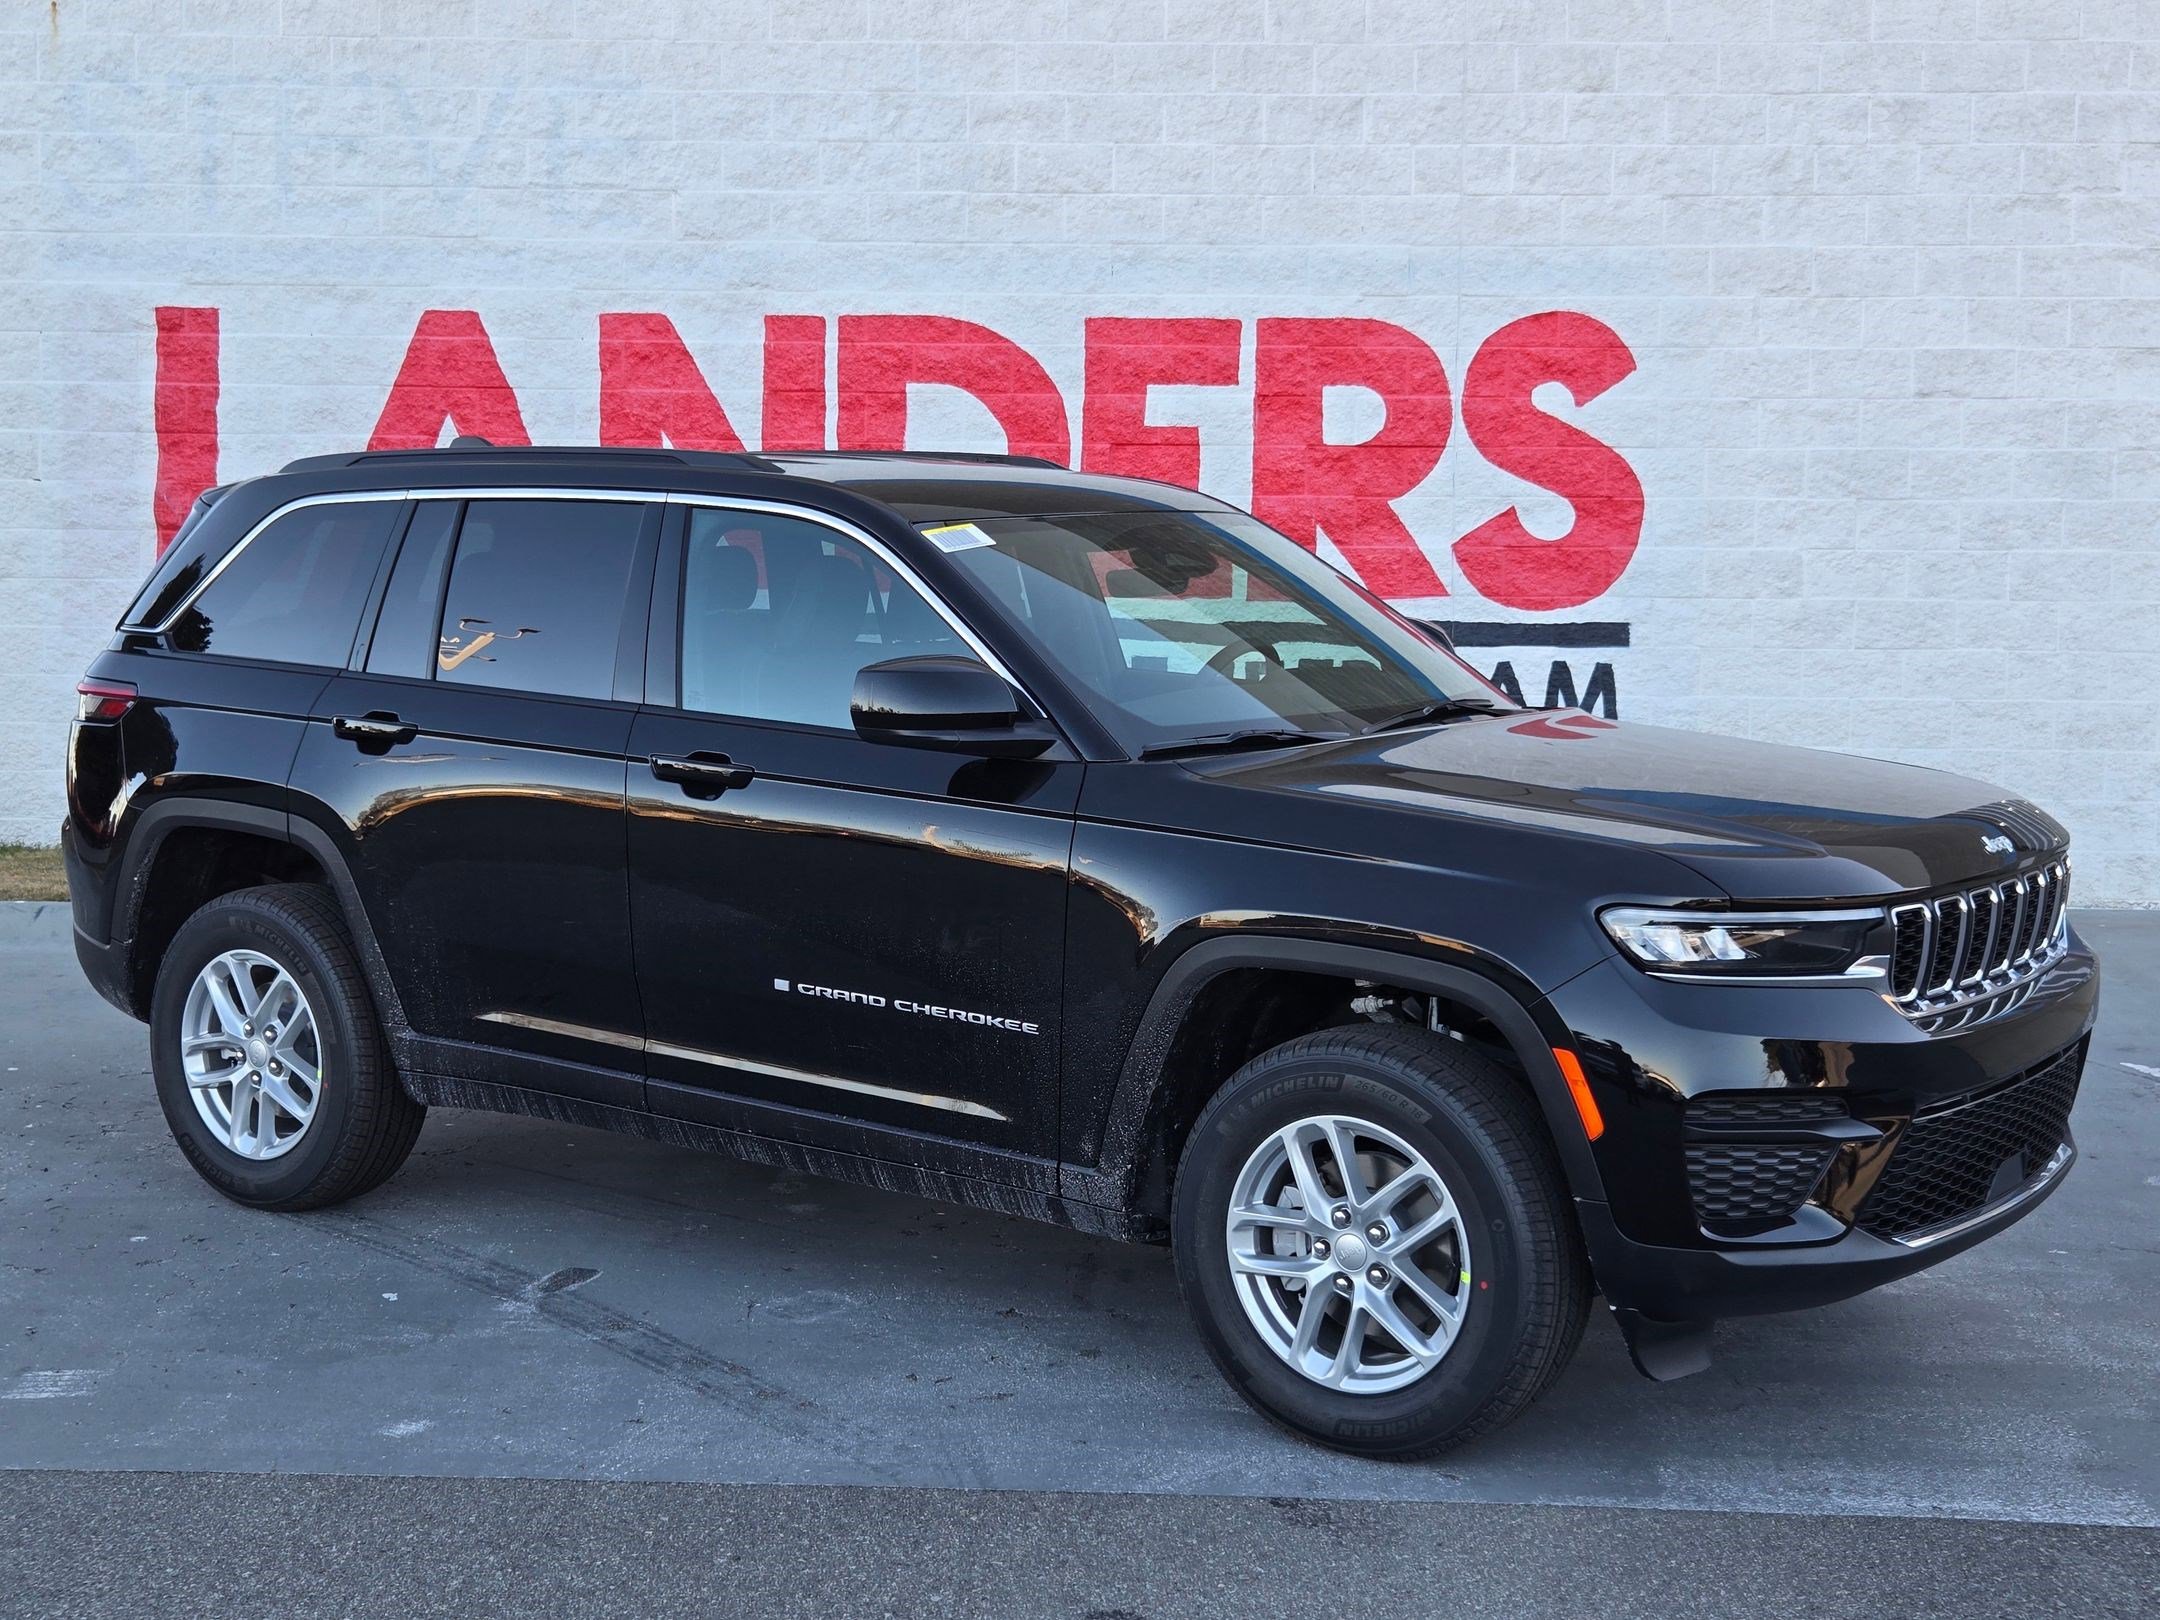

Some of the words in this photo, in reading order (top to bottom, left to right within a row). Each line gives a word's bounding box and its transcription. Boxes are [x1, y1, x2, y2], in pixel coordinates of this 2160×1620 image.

[797, 983, 886, 1007] GRAND
[894, 999, 1039, 1034] CHEROKEE
[1250, 1075, 1339, 1108] MICHELIN
